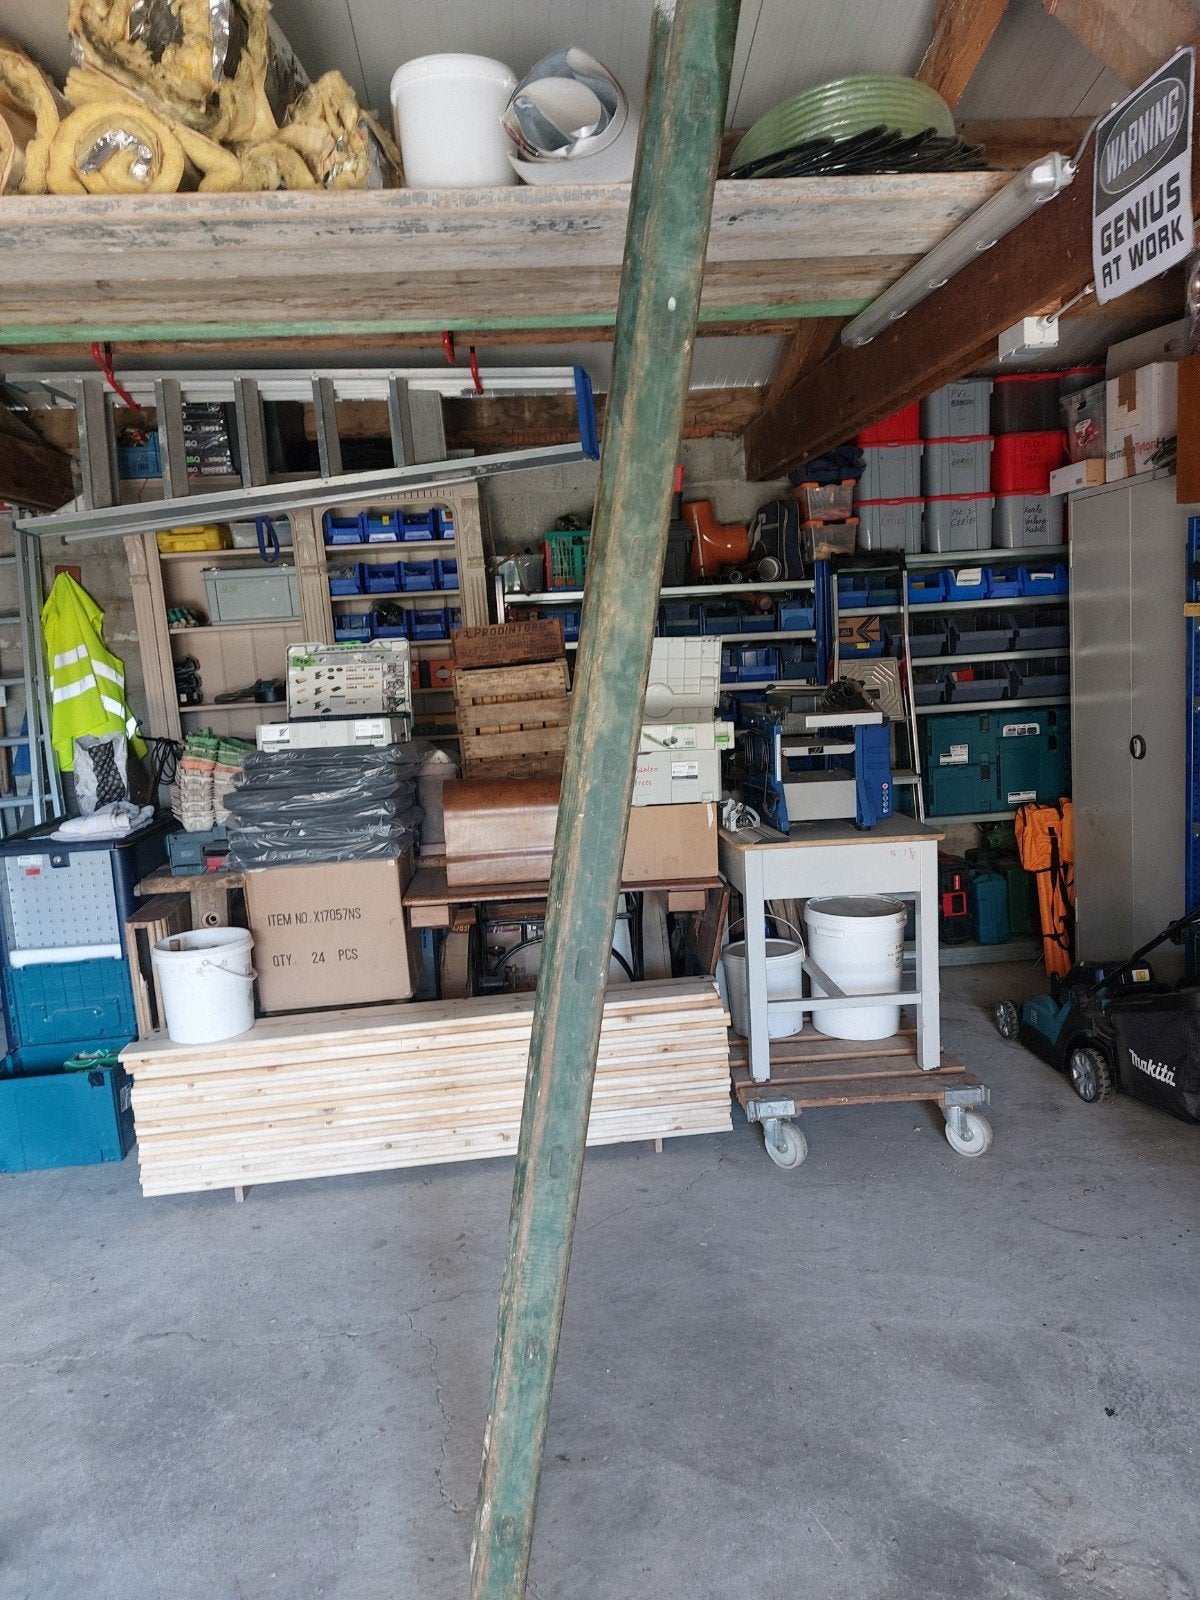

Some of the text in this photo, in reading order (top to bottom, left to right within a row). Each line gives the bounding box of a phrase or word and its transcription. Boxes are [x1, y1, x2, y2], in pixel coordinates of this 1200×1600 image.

[1106, 86, 1181, 185] WARNING
[1100, 172, 1181, 257] GENIUS
[1102, 215, 1184, 289] AT WORK
[267, 912, 292, 927] ITEM
[313, 907, 362, 923] X17057NS
[311, 951, 326, 964] 24
[338, 948, 359, 961] PCS
